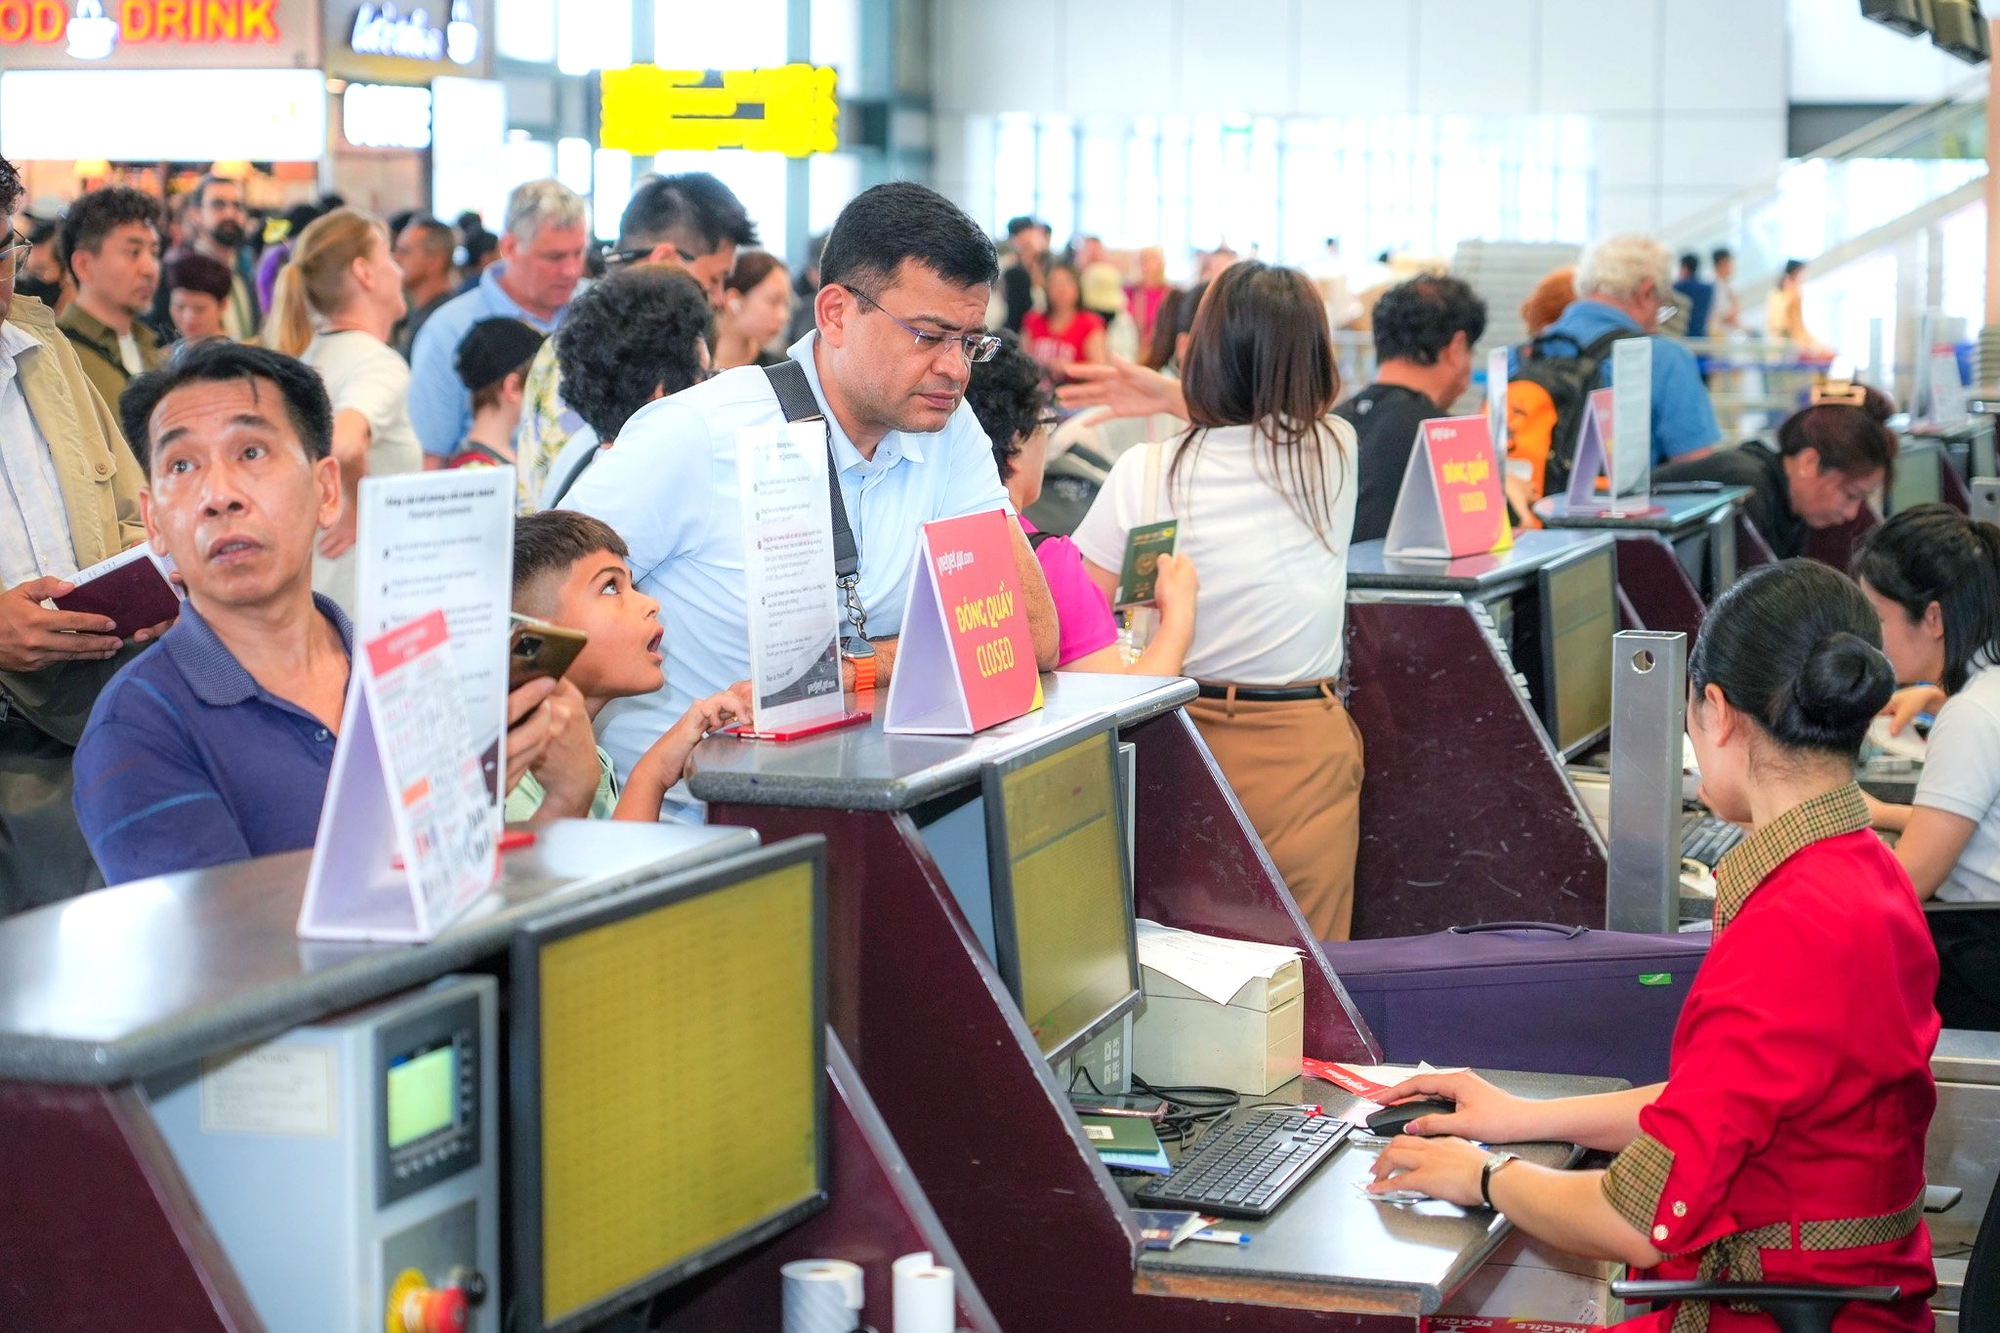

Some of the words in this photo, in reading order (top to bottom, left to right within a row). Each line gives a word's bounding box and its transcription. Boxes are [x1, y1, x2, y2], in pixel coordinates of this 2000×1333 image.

[119, 0, 281, 43] DRINK
[955, 596, 987, 634] ĐÓNG
[976, 636, 1015, 678] CLOSED
[1515, 1322, 1587, 1333] FRAGILE
